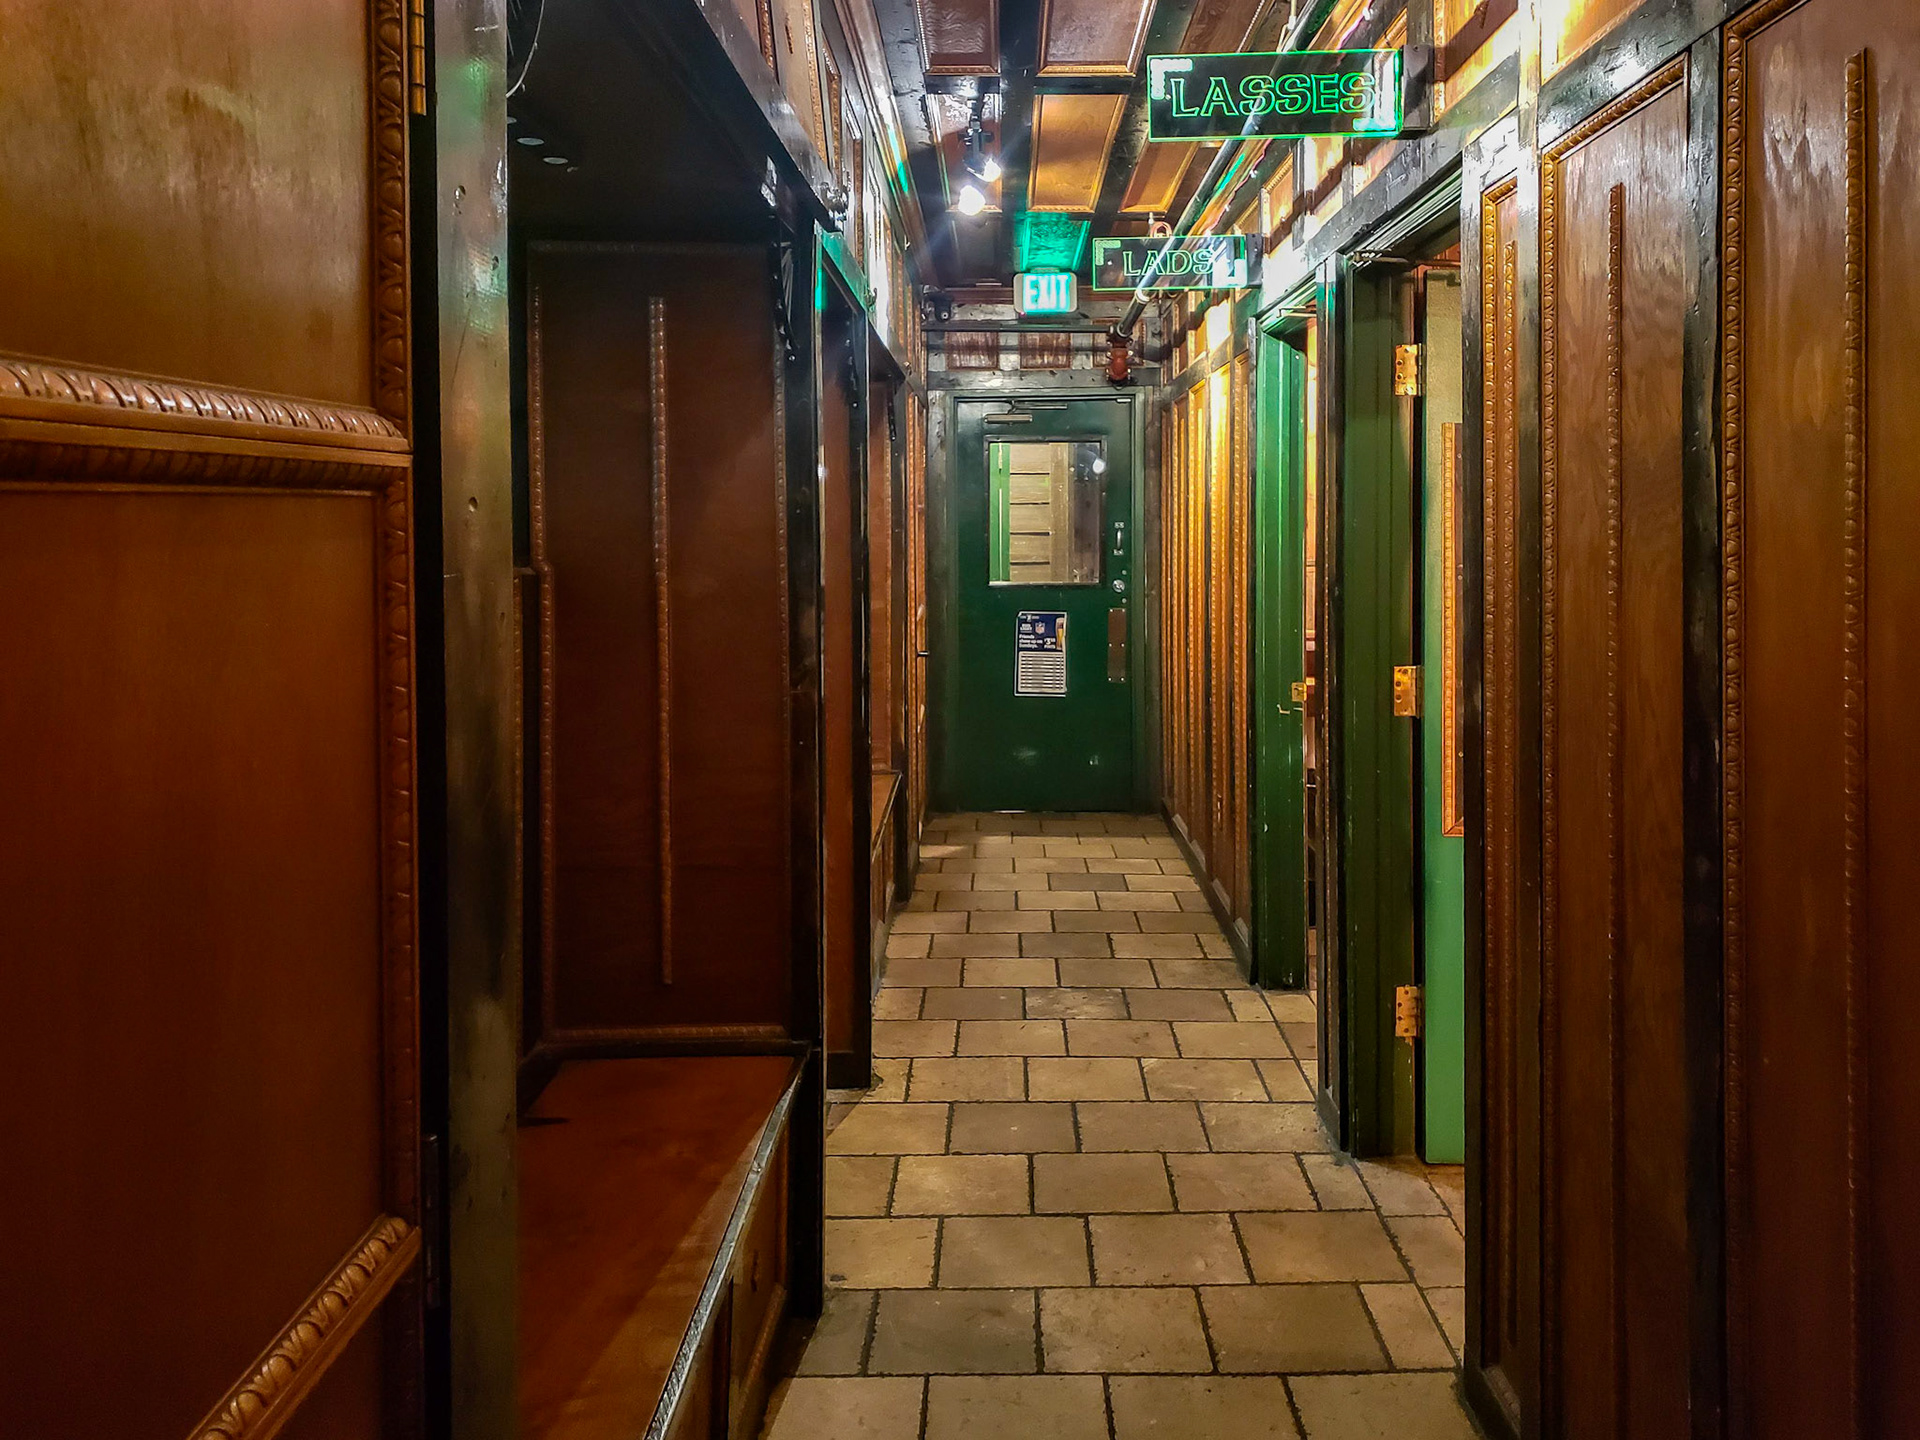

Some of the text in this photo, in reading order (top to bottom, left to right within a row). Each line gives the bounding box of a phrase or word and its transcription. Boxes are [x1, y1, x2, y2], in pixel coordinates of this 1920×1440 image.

[1169, 72, 1376, 118] LASSES
[1122, 249, 1215, 277] LADS
[1024, 274, 1071, 311] EXIT
